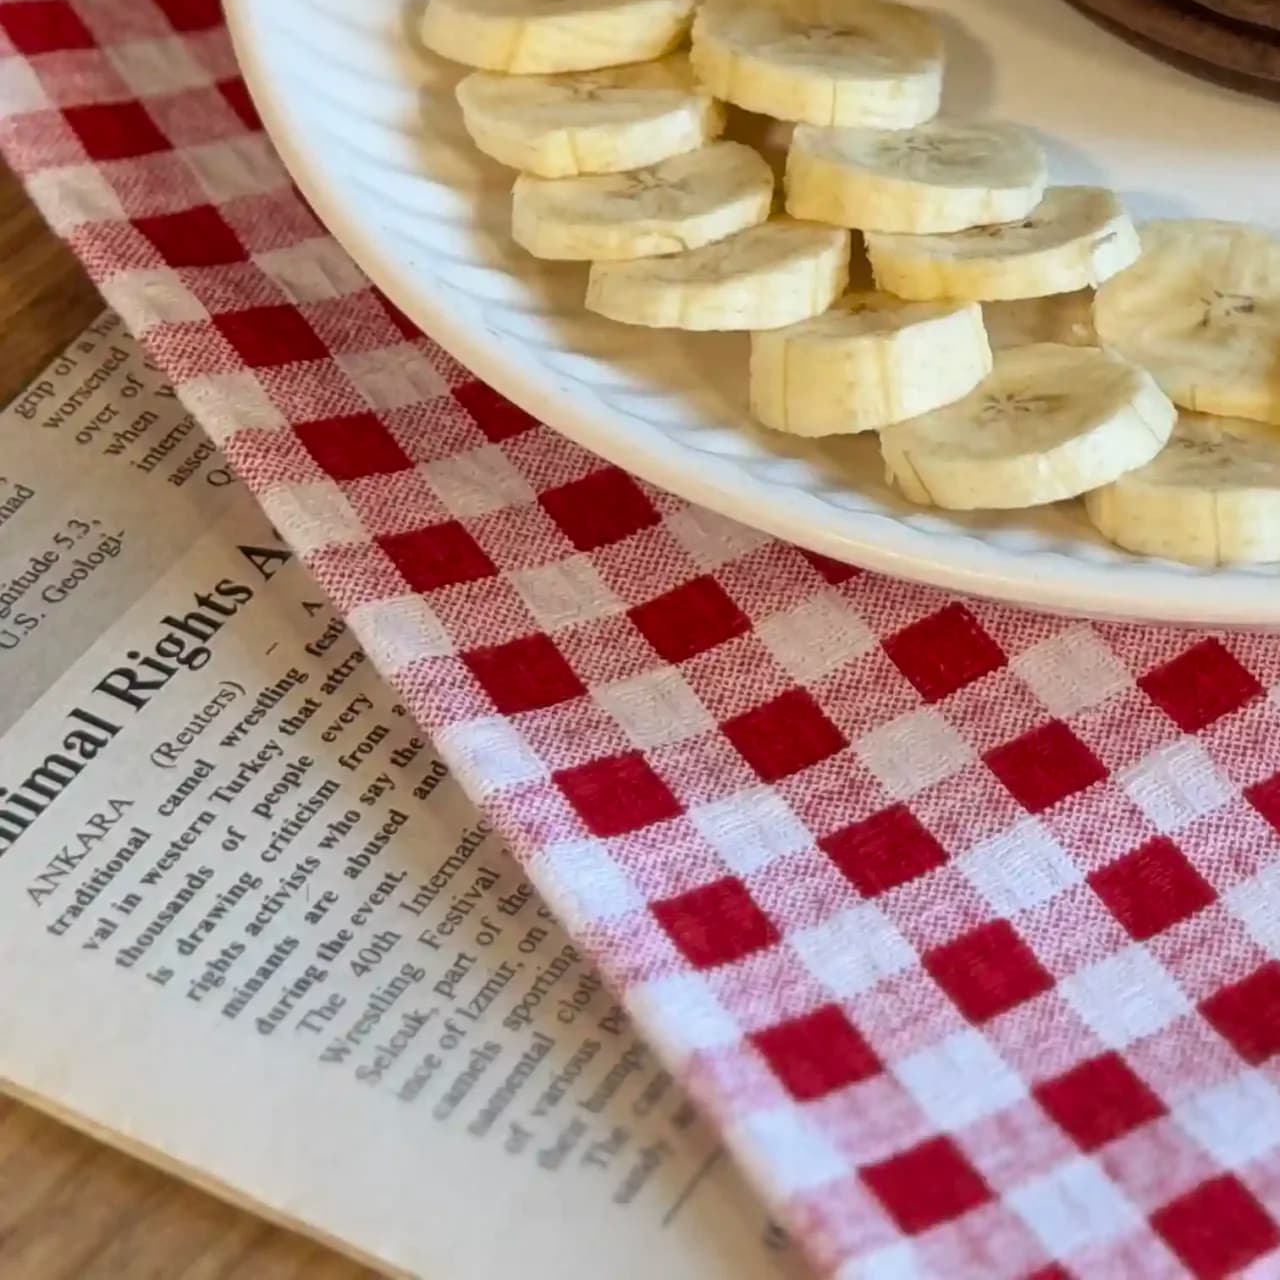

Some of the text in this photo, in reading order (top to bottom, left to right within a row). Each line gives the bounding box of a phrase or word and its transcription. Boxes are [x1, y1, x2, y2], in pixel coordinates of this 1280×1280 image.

[42, 345, 131, 430] worsened
[75, 372, 145, 446] over of
[103, 409, 160, 458] when
[0, 529, 125, 649] U.S. Geologi-
[53, 518, 102, 550] 5.3,
[0, 528, 294, 858] nimal Rights A
[26, 798, 135, 908] ANKARA
[150, 679, 247, 769] (Reuters)
[301, 600, 324, 618] A
[47, 825, 152, 938] traditional
[157, 757, 217, 817] camel
[220, 666, 310, 748] wrestling
[82, 916, 119, 953] val
[110, 891, 144, 916] in
[139, 808, 217, 887] western
[208, 738, 285, 805] Turkey
[278, 695, 323, 737] that
[114, 691, 374, 970] thousands of people every
[146, 965, 175, 987] is
[176, 870, 264, 957] drawing
[260, 777, 342, 864] criticism
[337, 722, 391, 773] from
[186, 735, 425, 1003] rights activists who say the
[220, 758, 449, 1021] minants are abused and
[254, 869, 409, 1037] during the event.
[294, 990, 348, 1036] The
[349, 928, 404, 980] 40th
[318, 866, 502, 1066] Wrestling Festival
[354, 881, 535, 1088] Selcuk, part of the
[438, 1017, 468, 1052] of
[516, 925, 549, 954] on
[502, 942, 583, 1033] sporting
